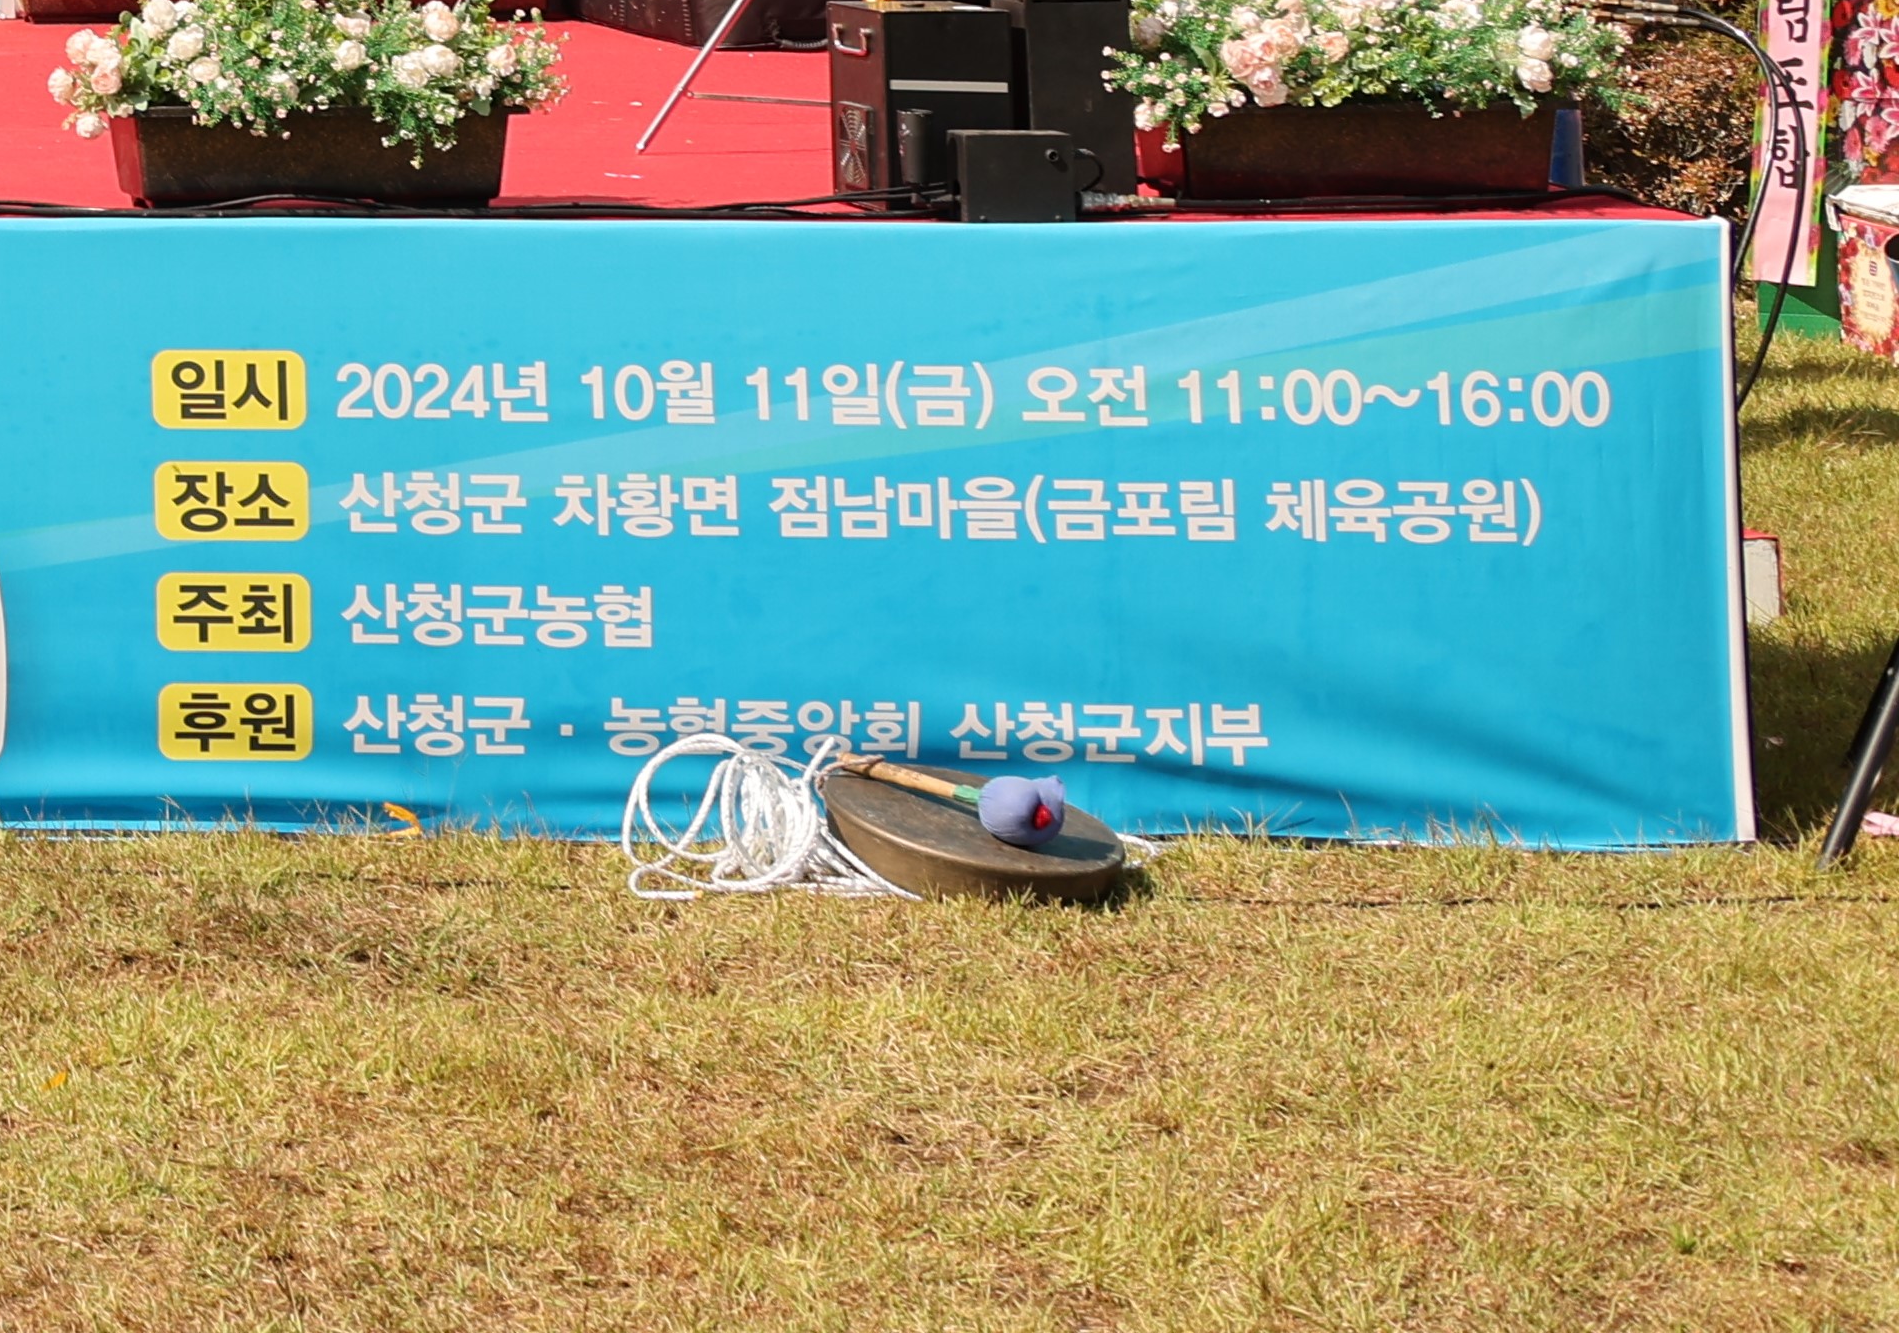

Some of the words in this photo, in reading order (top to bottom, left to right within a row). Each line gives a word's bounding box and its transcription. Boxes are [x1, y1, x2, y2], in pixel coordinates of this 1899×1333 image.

[170, 362, 284, 423] 일시
[336, 360, 550, 427] 2024년
[581, 360, 716, 427] 10월
[748, 360, 994, 430] 11일(금)
[1022, 365, 1149, 430] 오전
[1179, 367, 1611, 429] 11:00~16:00
[172, 471, 294, 535] 장소
[340, 469, 526, 537] 산청군
[553, 472, 741, 540] 차황면
[770, 472, 1237, 544] 점남마을(금포림
[1266, 475, 1541, 547] 체육공원)
[172, 583, 294, 646] 주최
[341, 583, 656, 649] 산청군농협
[175, 692, 295, 756] 후원
[343, 692, 530, 758] 산청군
[604, 697, 920, 760] 농협중앙회
[950, 701, 1269, 766] 산청군지부
